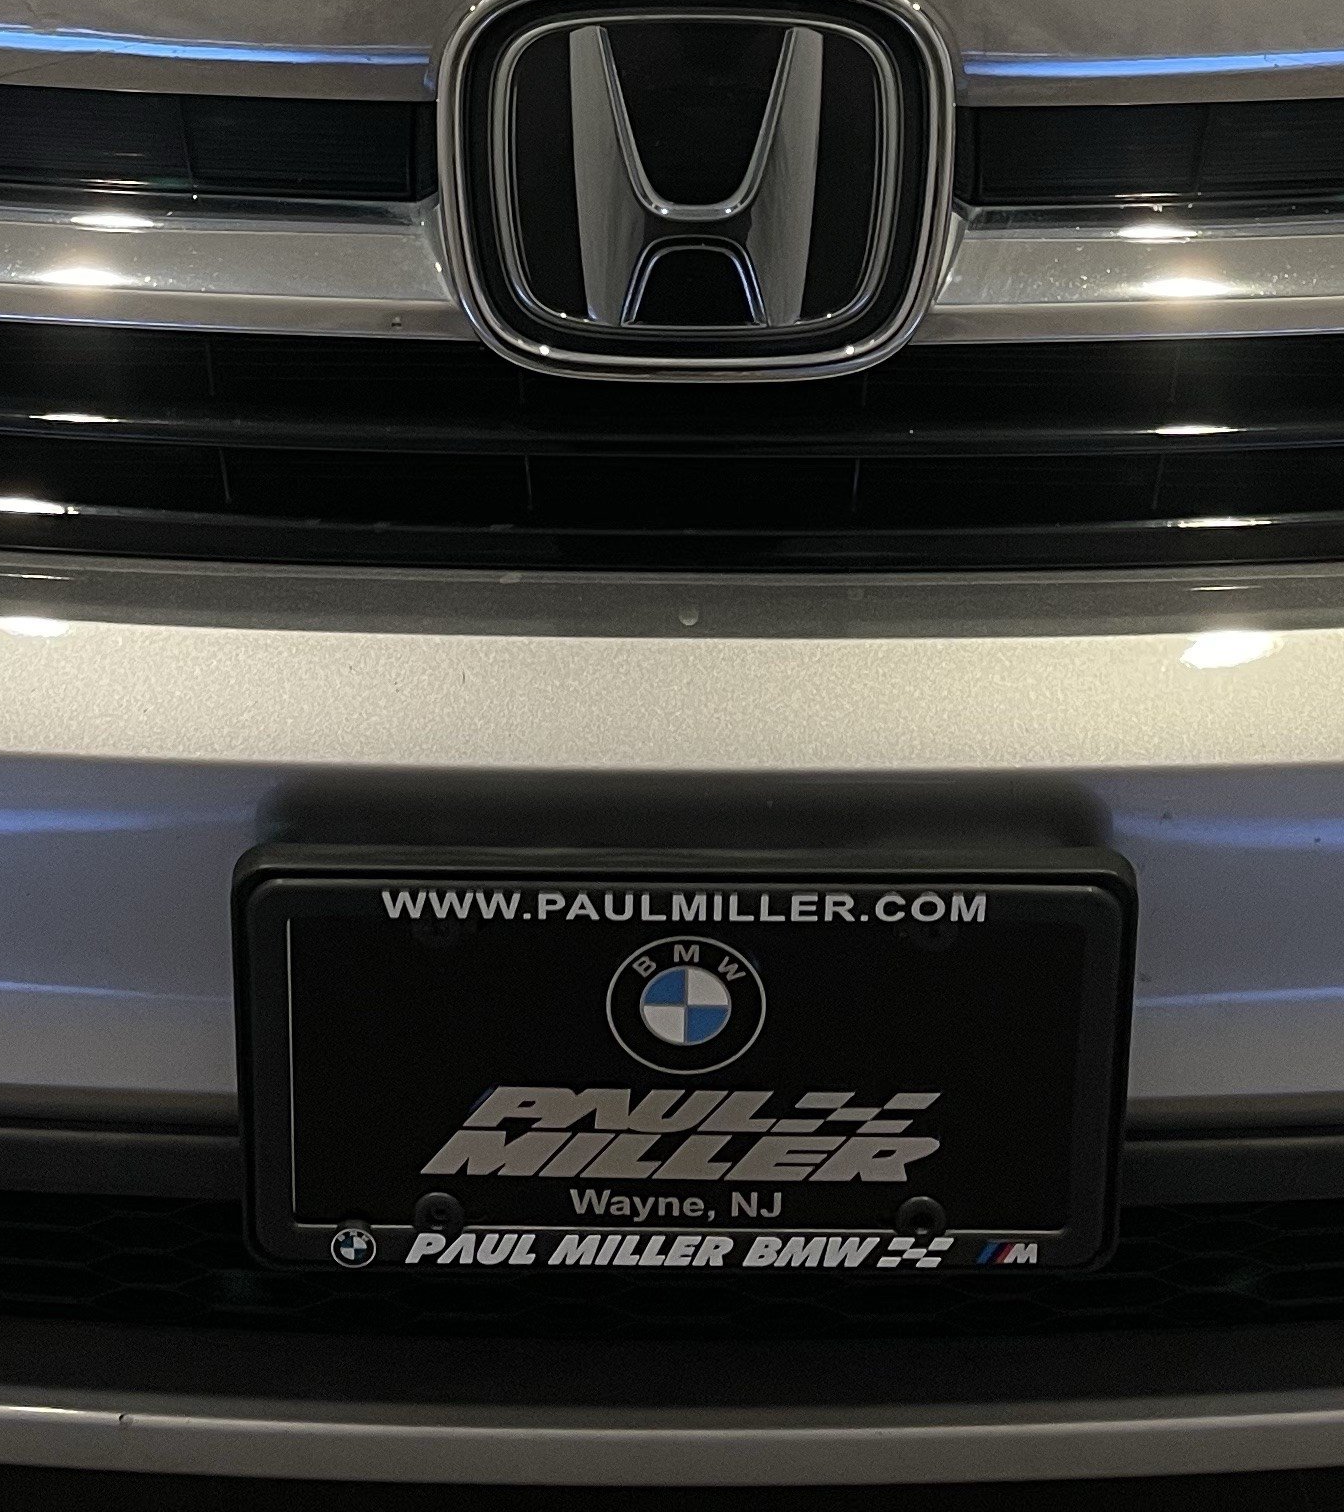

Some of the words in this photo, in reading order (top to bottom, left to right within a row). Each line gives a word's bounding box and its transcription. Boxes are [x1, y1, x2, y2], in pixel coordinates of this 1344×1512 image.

[381, 890, 987, 922] WWW.PAULMILLER.COM
[632, 944, 746, 982] BMW
[462, 1087, 778, 1133] PAUL
[420, 1129, 940, 1182] MILLER
[569, 1189, 716, 1222] Wayne,
[731, 1191, 782, 1218] NJ
[405, 1232, 537, 1265] PAUL
[548, 1235, 734, 1267] MILLER
[742, 1237, 880, 1267] BMW
